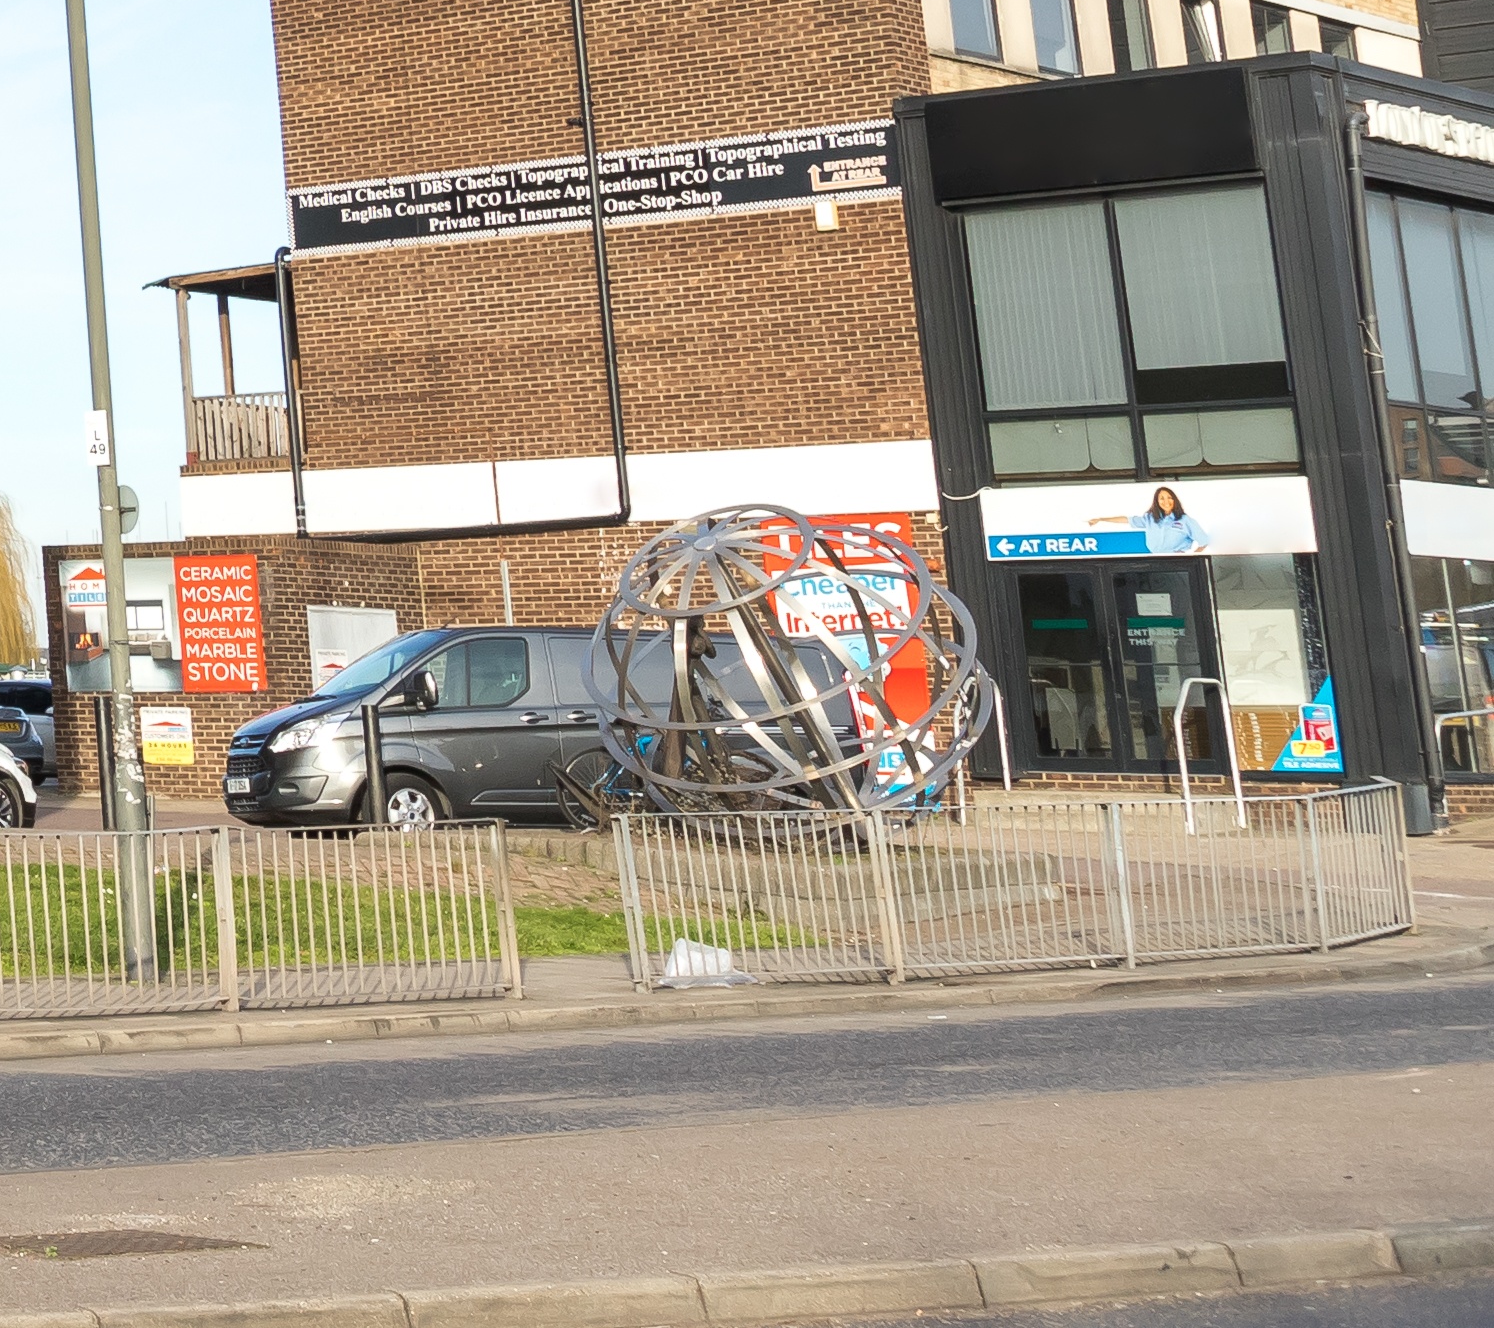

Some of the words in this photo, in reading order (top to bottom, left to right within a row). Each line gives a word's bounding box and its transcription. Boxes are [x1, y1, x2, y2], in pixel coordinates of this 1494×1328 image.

[298, 190, 353, 209] Medical
[355, 185, 406, 203] Checks
[420, 178, 453, 196] DBS
[455, 173, 508, 192] Checks
[518, 158, 625, 186] Topograpical
[627, 152, 696, 172] Training
[706, 136, 823, 163] Topographical
[825, 130, 887, 149] Testing
[823, 154, 887, 173] ENTRANCE
[847, 166, 882, 181] REAR
[340, 204, 392, 224] English
[394, 200, 452, 217] Courses
[465, 192, 502, 209] PCO
[505, 186, 562, 204] Licence
[563, 176, 658, 202] Appications
[669, 169, 708, 187] PCO
[712, 166, 744, 182] Car
[746, 161, 785, 179] Hire
[428, 215, 481, 233] Private
[482, 211, 517, 227] Hire
[519, 204, 593, 223] Insurance
[603, 189, 723, 214] One-Stop-Shop
[94, 430, 101, 441] L
[89, 443, 106, 455] 49
[1018, 538, 1041, 553] AT
[1045, 537, 1098, 553] REAR
[179, 565, 253, 582] CERAMIC
[181, 585, 253, 603] MOSAIC
[183, 606, 255, 623] QUARTZ
[184, 627, 257, 639] PORCELAIN
[186, 642, 258, 659] MARBLE
[1128, 638, 1153, 647] THIS
[188, 662, 260, 682] STONE
